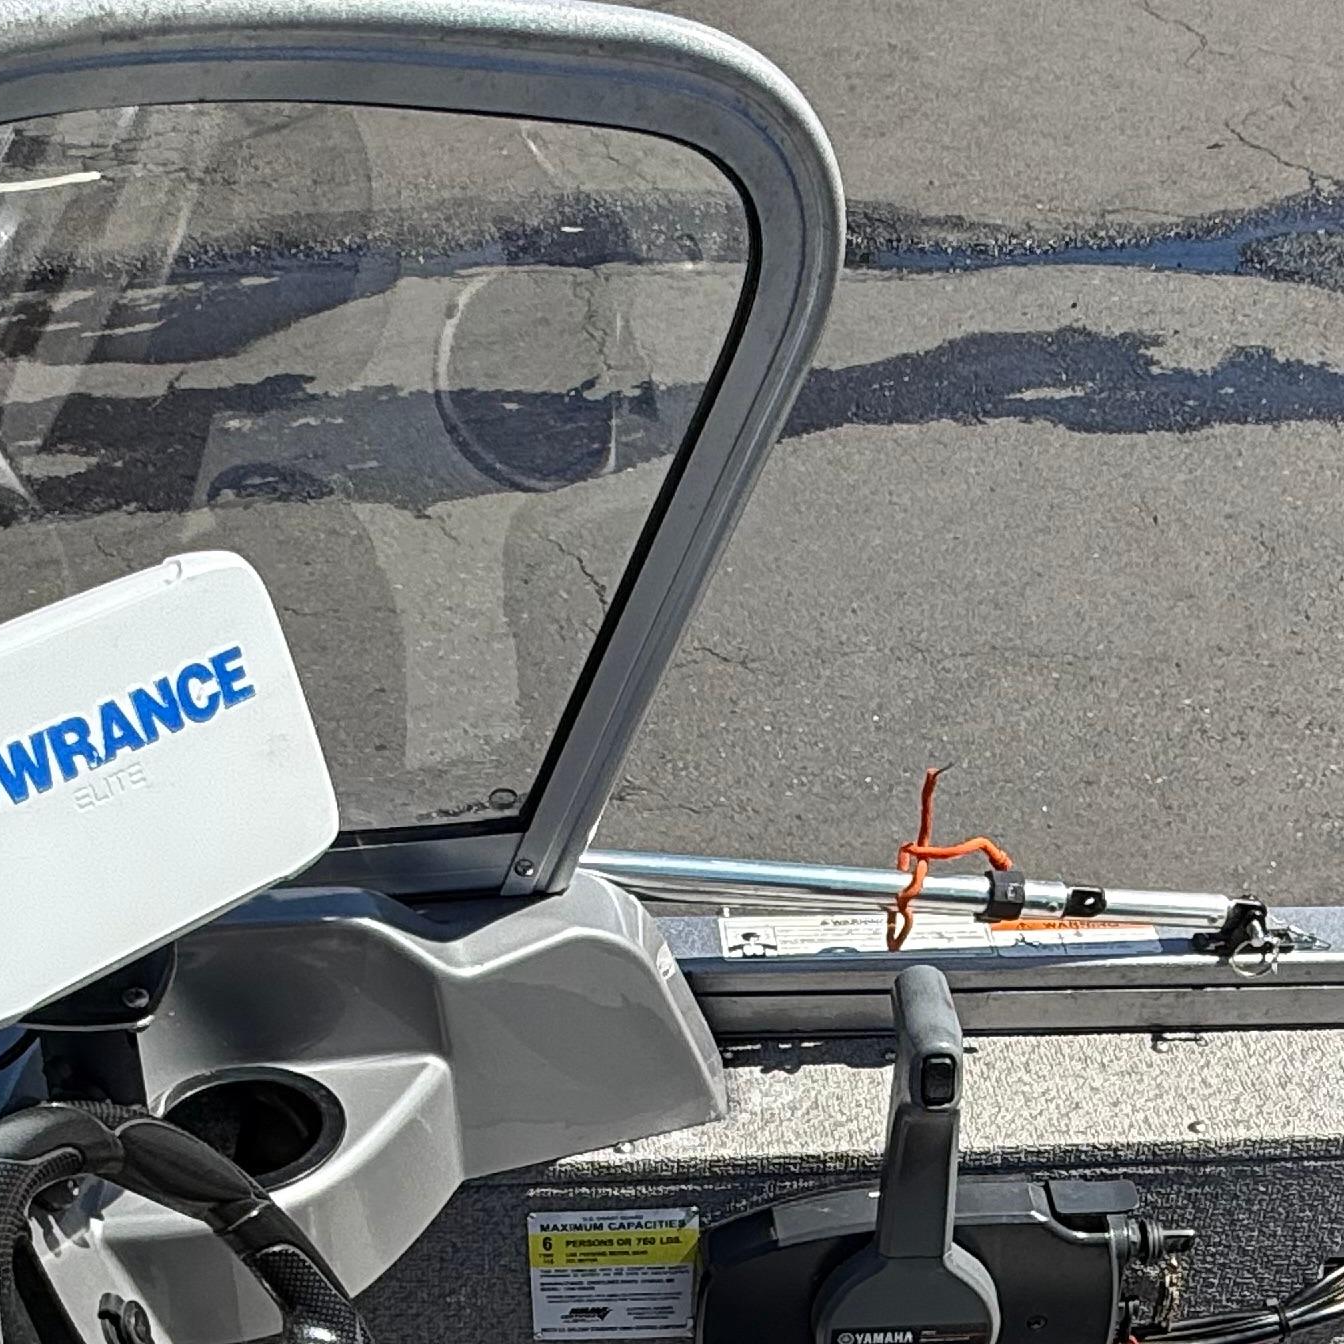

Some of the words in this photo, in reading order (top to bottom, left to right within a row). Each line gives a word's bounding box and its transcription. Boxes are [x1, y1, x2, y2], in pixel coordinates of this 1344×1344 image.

[72, 760, 147, 810] ELITE
[540, 1222, 604, 1232] MAXIMUM
[608, 1219, 686, 1231] CAPACITIES
[542, 1237, 553, 1251] 6
[855, 1331, 913, 1344] YAMAHA
